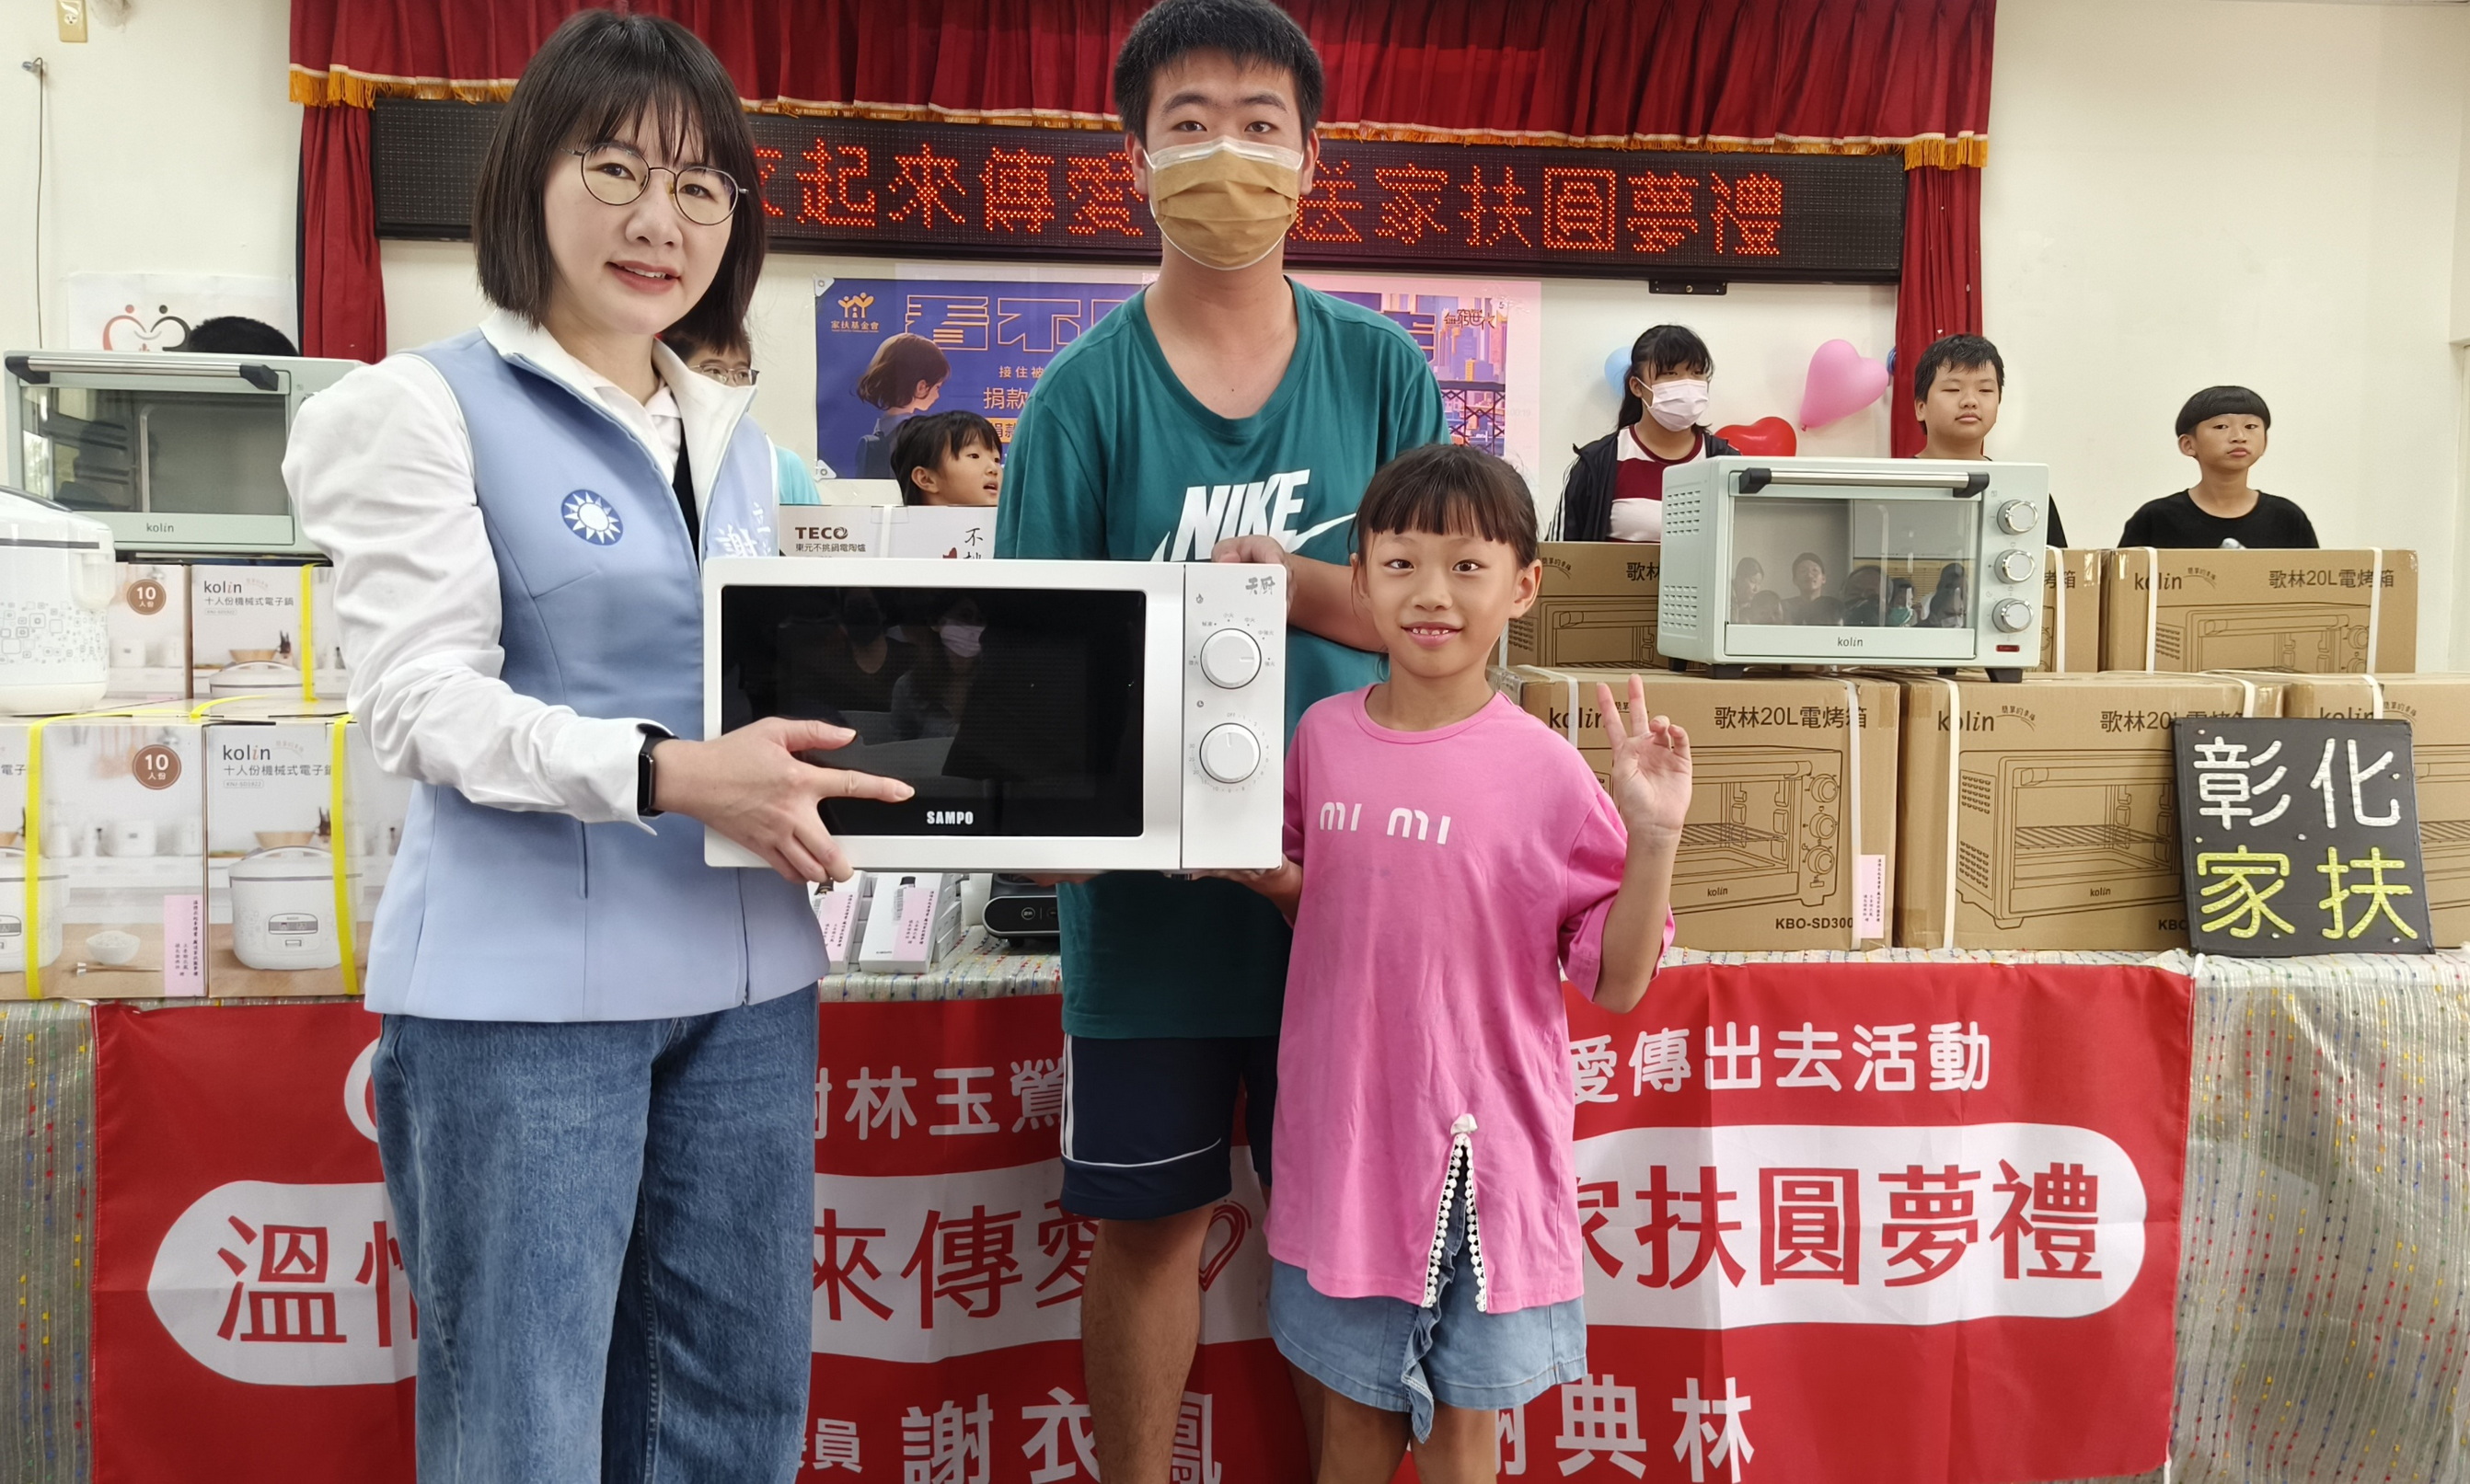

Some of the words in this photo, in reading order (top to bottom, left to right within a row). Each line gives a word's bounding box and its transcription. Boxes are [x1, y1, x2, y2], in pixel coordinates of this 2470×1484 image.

[1289, 158, 1783, 256] 送家扶圓夢禮
[983, 386, 1028, 410] 捐款
[1171, 468, 1310, 561] NIKE
[145, 522, 175, 534] kolin
[795, 526, 848, 540] TECO
[204, 581, 242, 594] kolin
[2268, 569, 2395, 589] 歌林20L電烤箱
[136, 586, 156, 600] 10
[1837, 637, 1864, 648] kolin
[223, 744, 271, 761] kolin
[144, 754, 169, 771] 10
[147, 772, 167, 780] 人份
[2193, 736, 2401, 831] 彰化
[927, 811, 974, 825] SAMPO
[1707, 887, 1728, 897] kolin
[2090, 887, 2111, 897] kolin
[2196, 844, 2419, 939] 家扶
[1567, 1021, 1991, 1104] 愛傳出去活動
[800, 1418, 863, 1474] 員
